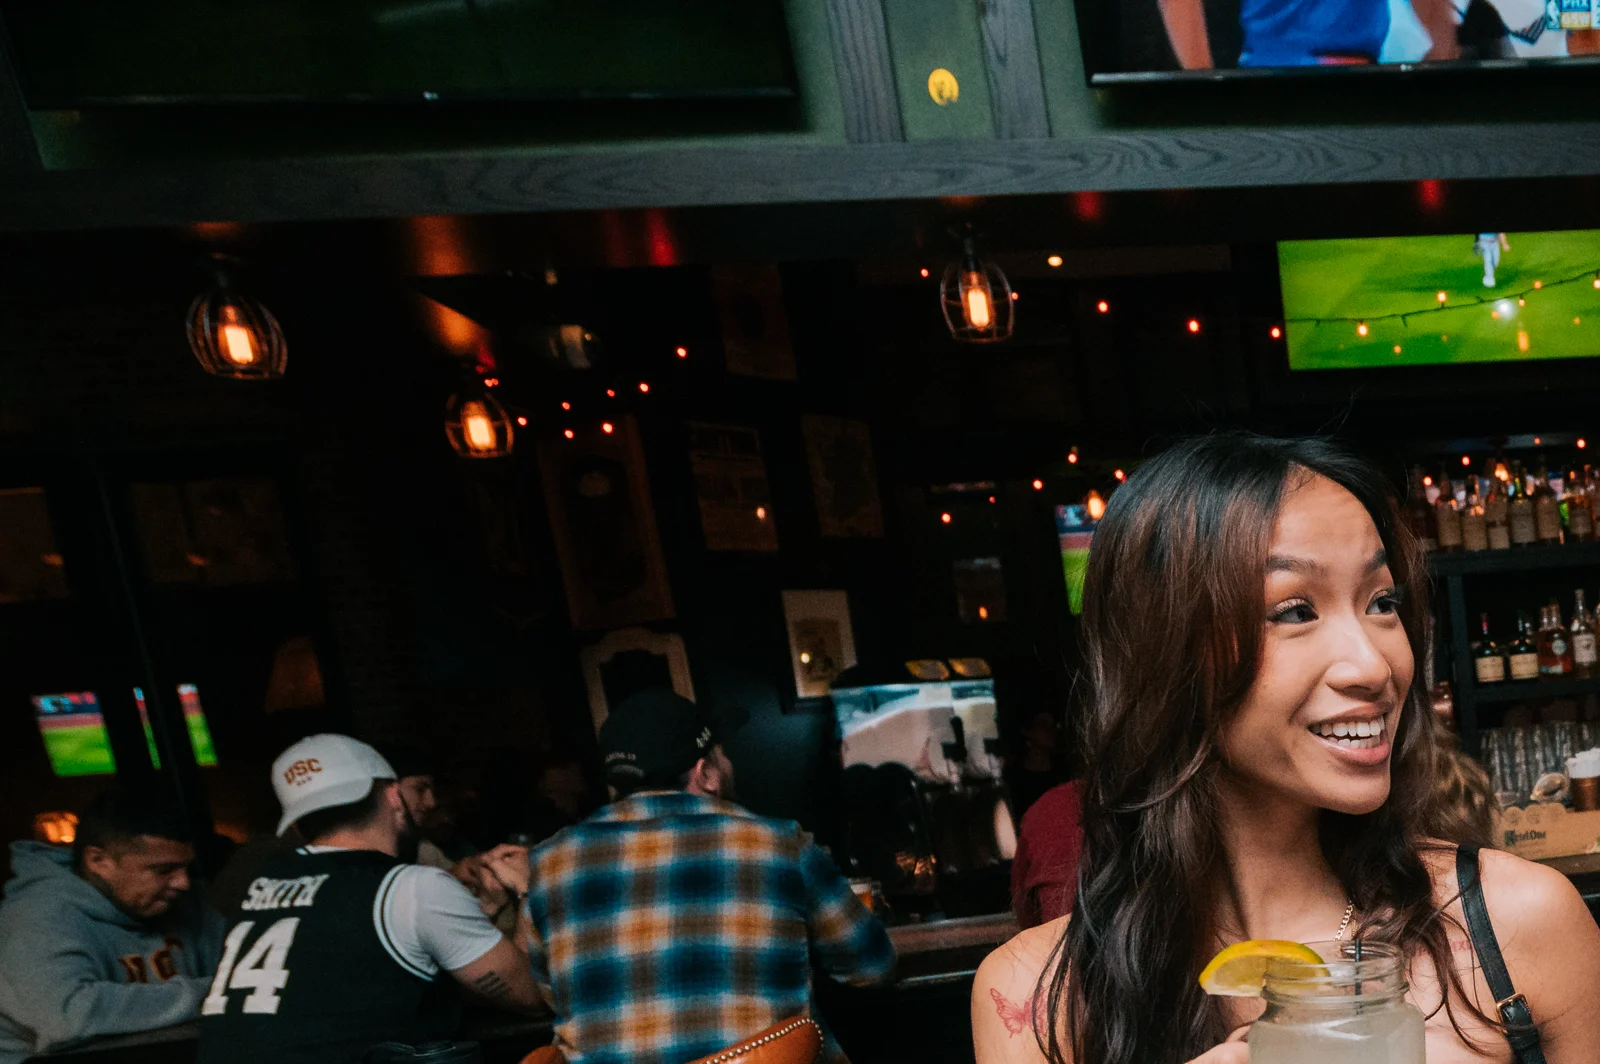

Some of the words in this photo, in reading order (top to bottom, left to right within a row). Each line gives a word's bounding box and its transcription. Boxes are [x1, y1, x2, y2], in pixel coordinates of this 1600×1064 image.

[283, 758, 323, 785] USC
[241, 873, 331, 911] SMITH
[201, 916, 300, 1016] 14
